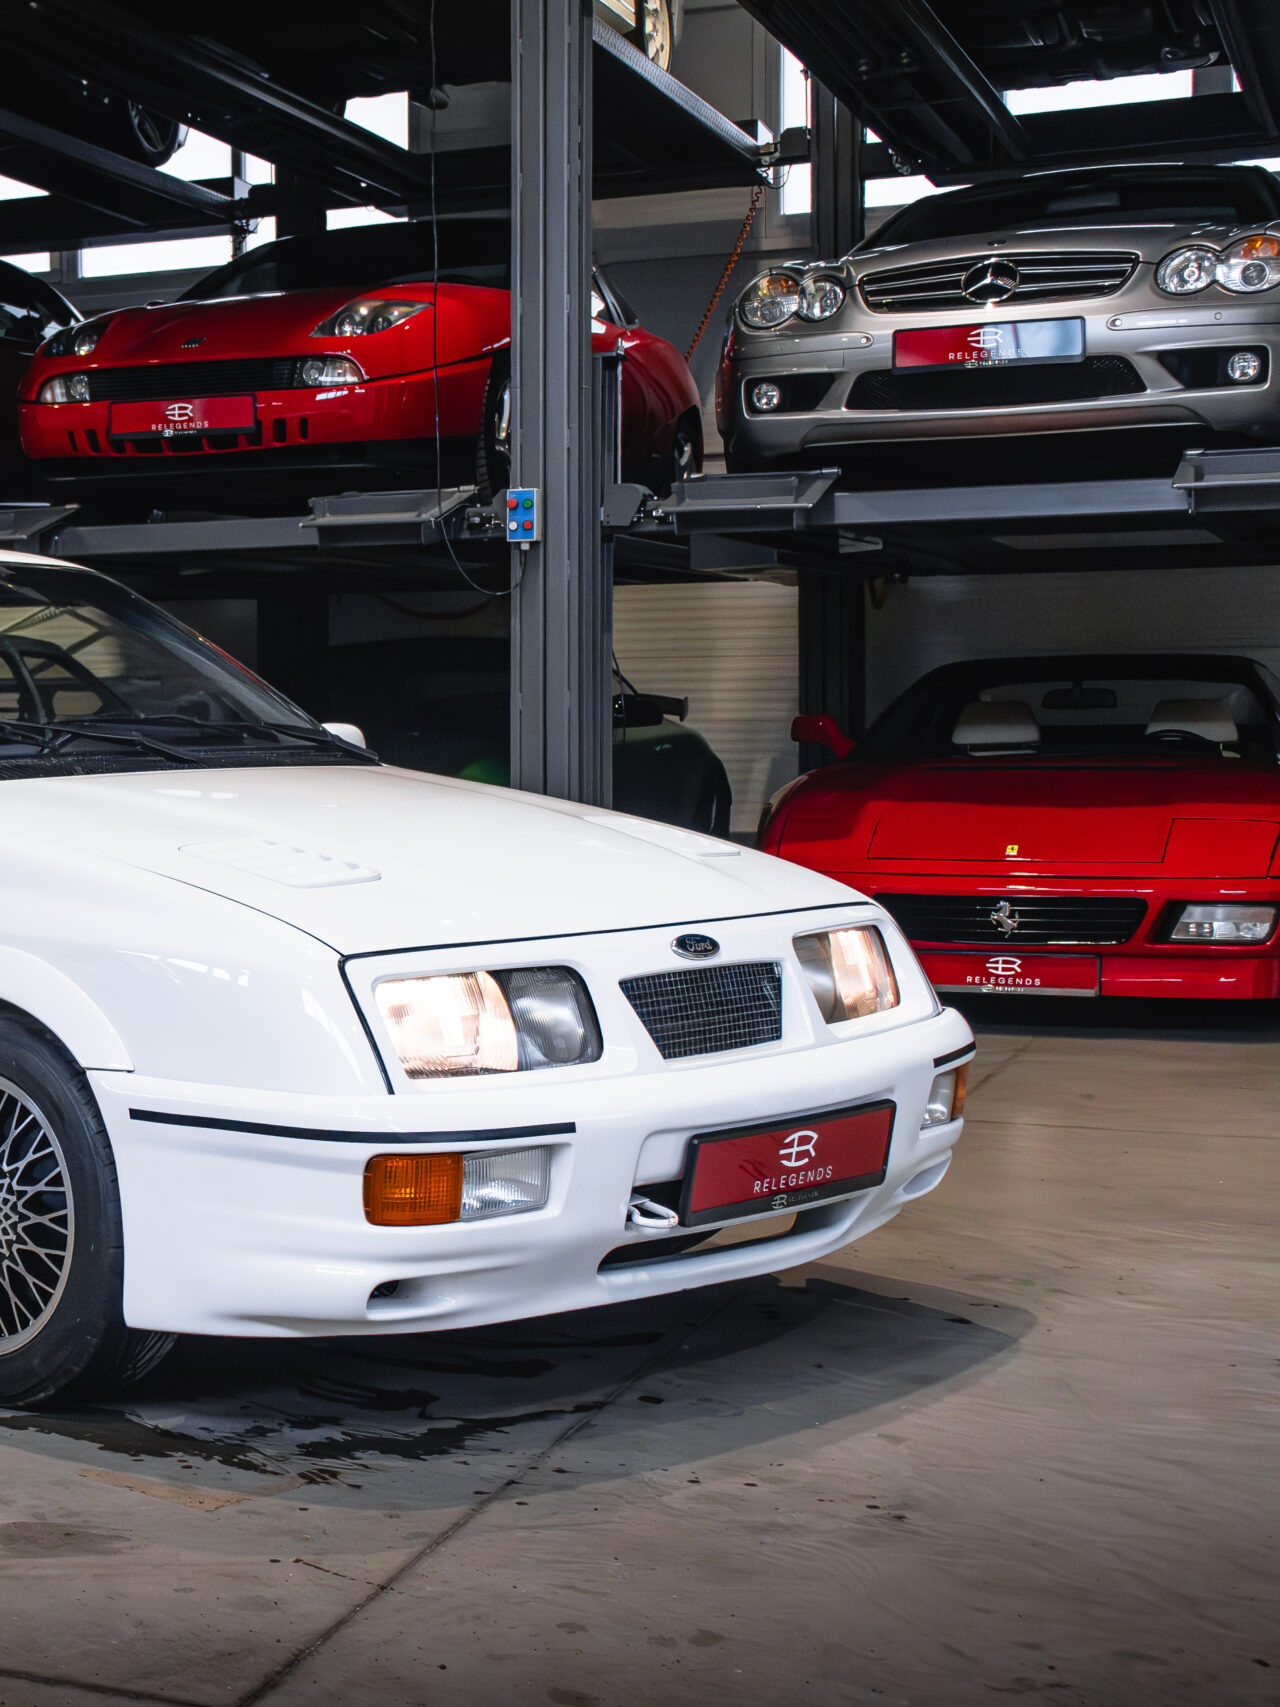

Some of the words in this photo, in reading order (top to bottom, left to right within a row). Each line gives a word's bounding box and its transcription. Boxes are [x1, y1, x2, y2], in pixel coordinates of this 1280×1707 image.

[948, 349, 1024, 360] RELEGENDS
[151, 421, 209, 431] RELEGENDS
[686, 936, 713, 952] Ford
[966, 976, 1041, 986] RELEGENDS
[753, 1165, 833, 1194] RELEGENDS
